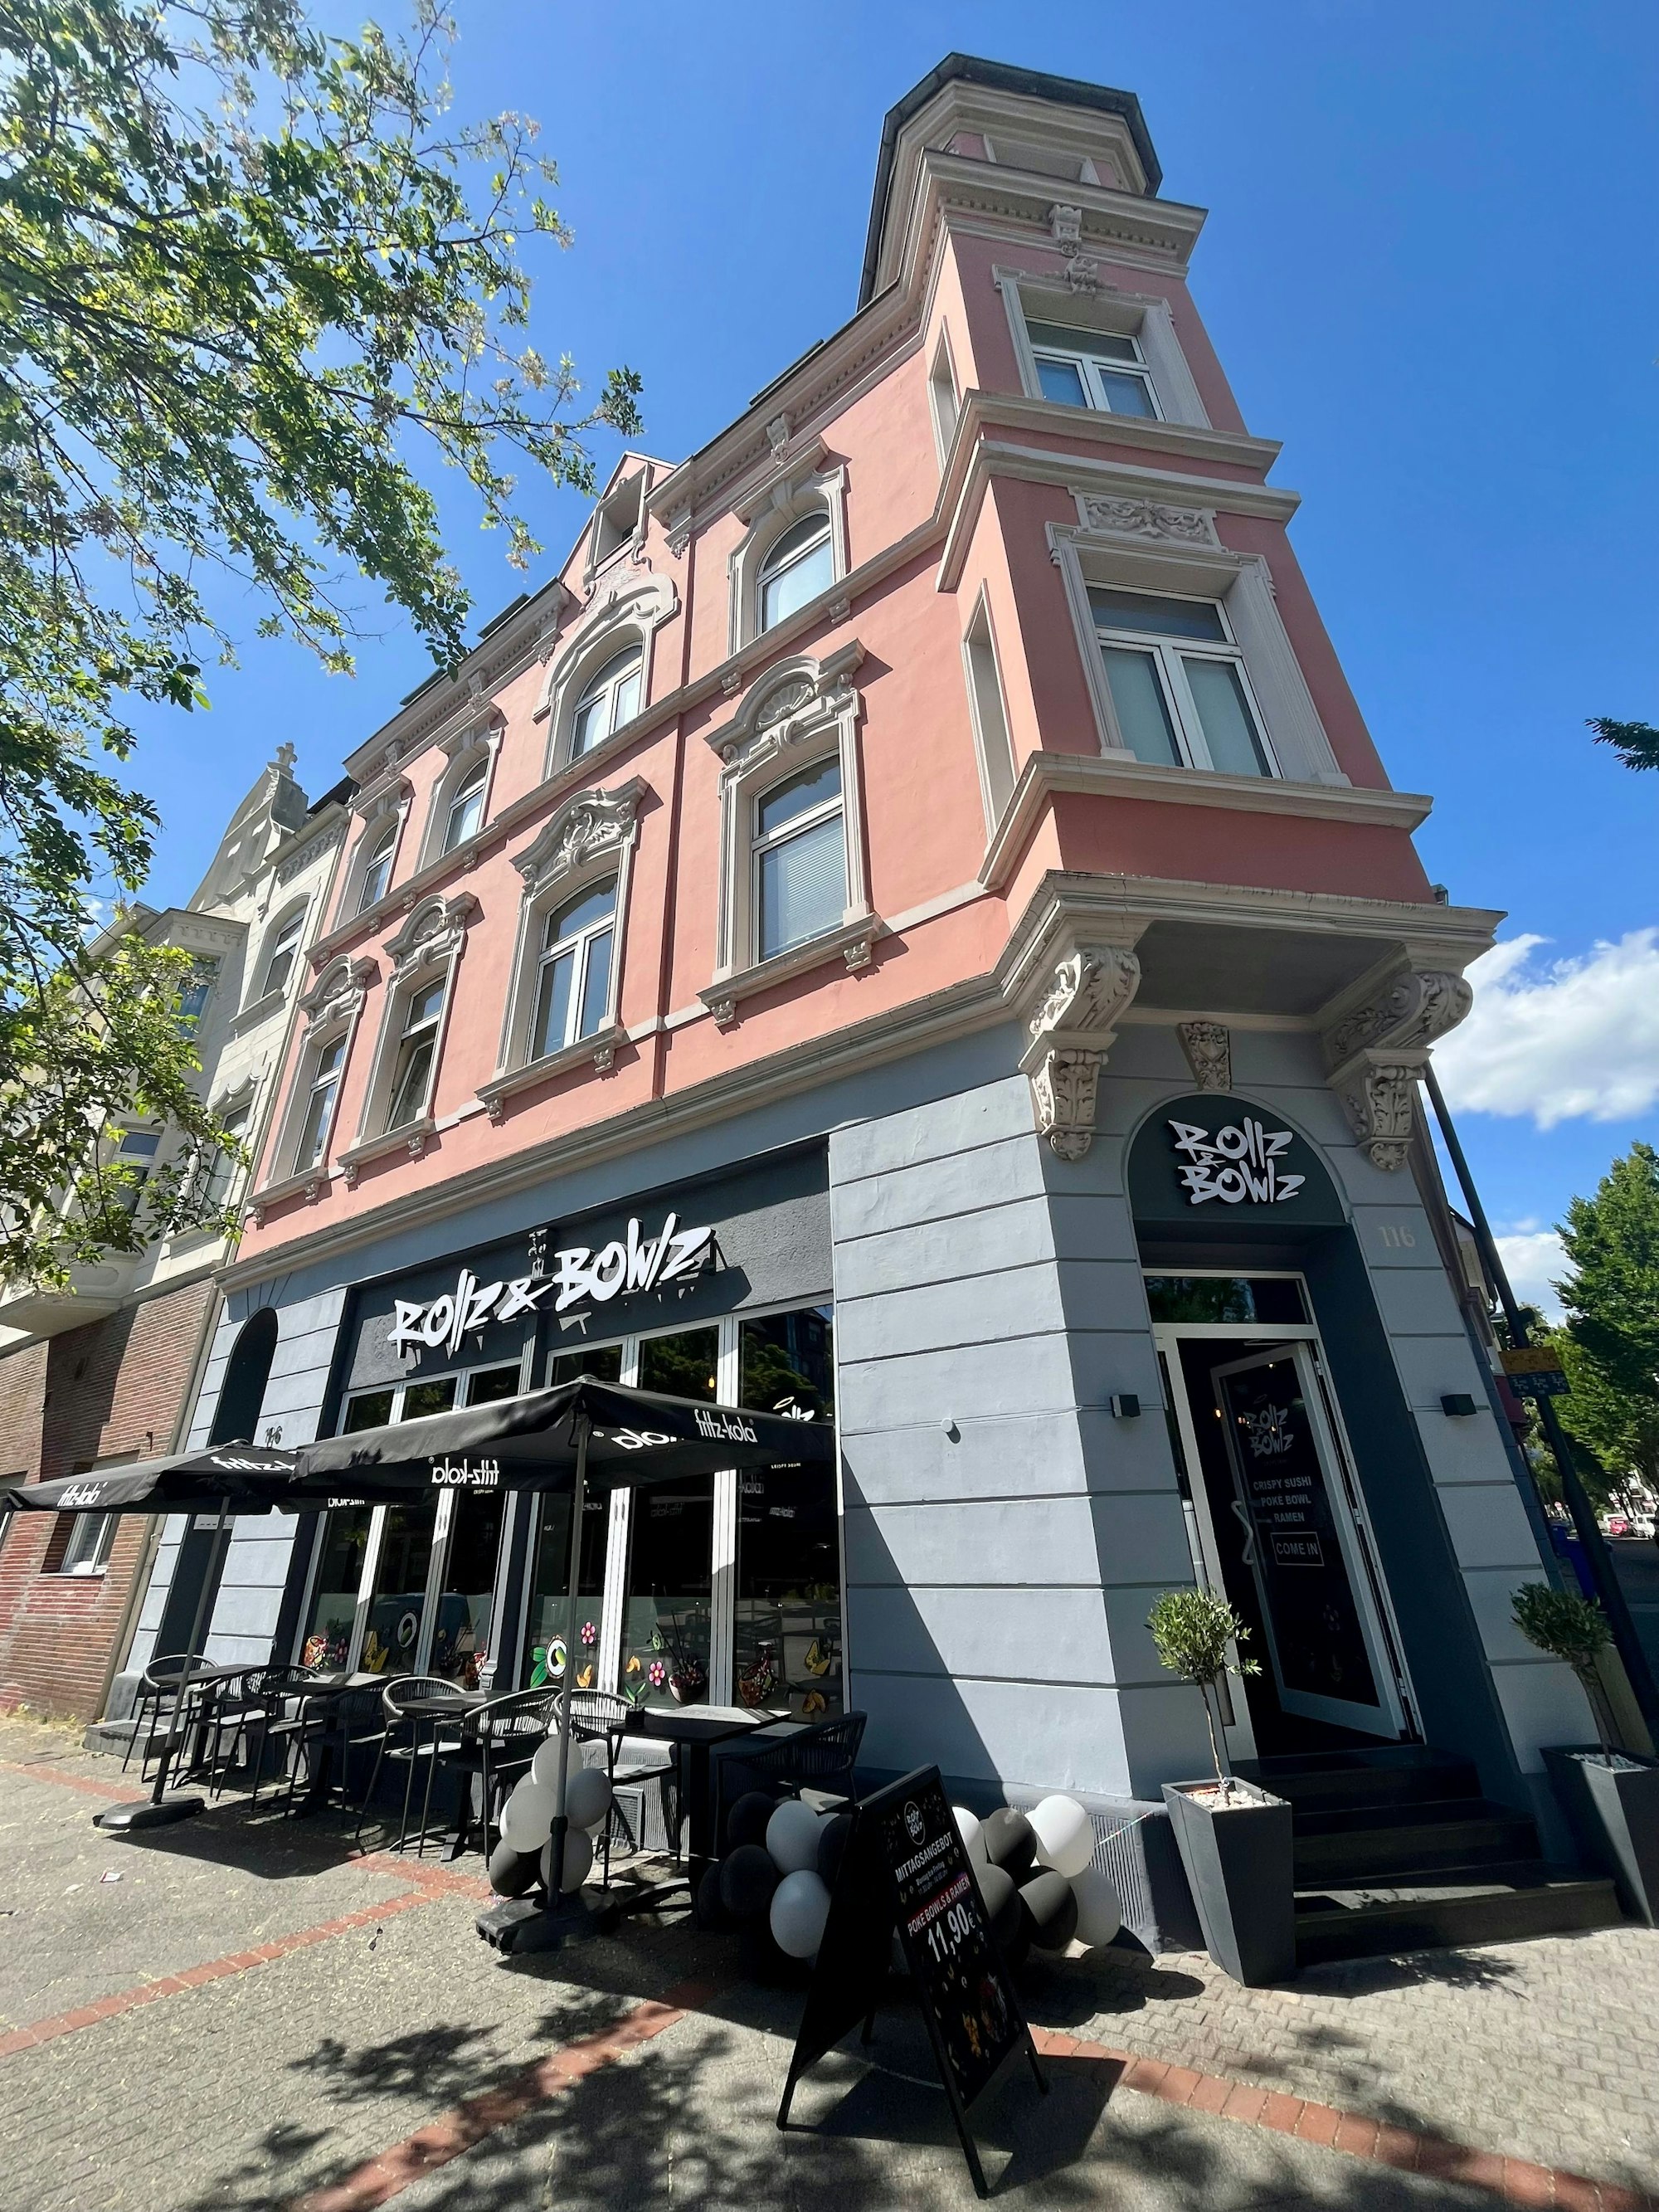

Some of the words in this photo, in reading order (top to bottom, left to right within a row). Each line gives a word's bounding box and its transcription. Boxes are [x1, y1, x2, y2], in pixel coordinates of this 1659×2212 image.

[1378, 1226, 1415, 1248] 116
[498, 1278, 553, 1321] &
[694, 1409, 757, 1443] fritz-kola
[1253, 1479, 1282, 1491] CRISPY
[1285, 1476, 1312, 1488] SUSHI
[1285, 1493, 1311, 1505] BOWL
[1274, 1512, 1305, 1523] RAMEN
[1276, 1542, 1306, 1555] COME
[1306, 1542, 1319, 1555] IN
[895, 1831, 953, 1883] MITTAGSANGEBOT
[907, 1912, 927, 1937] POKE
[925, 1895, 946, 1922] BOWLS
[950, 1874, 971, 1901] RAMEN
